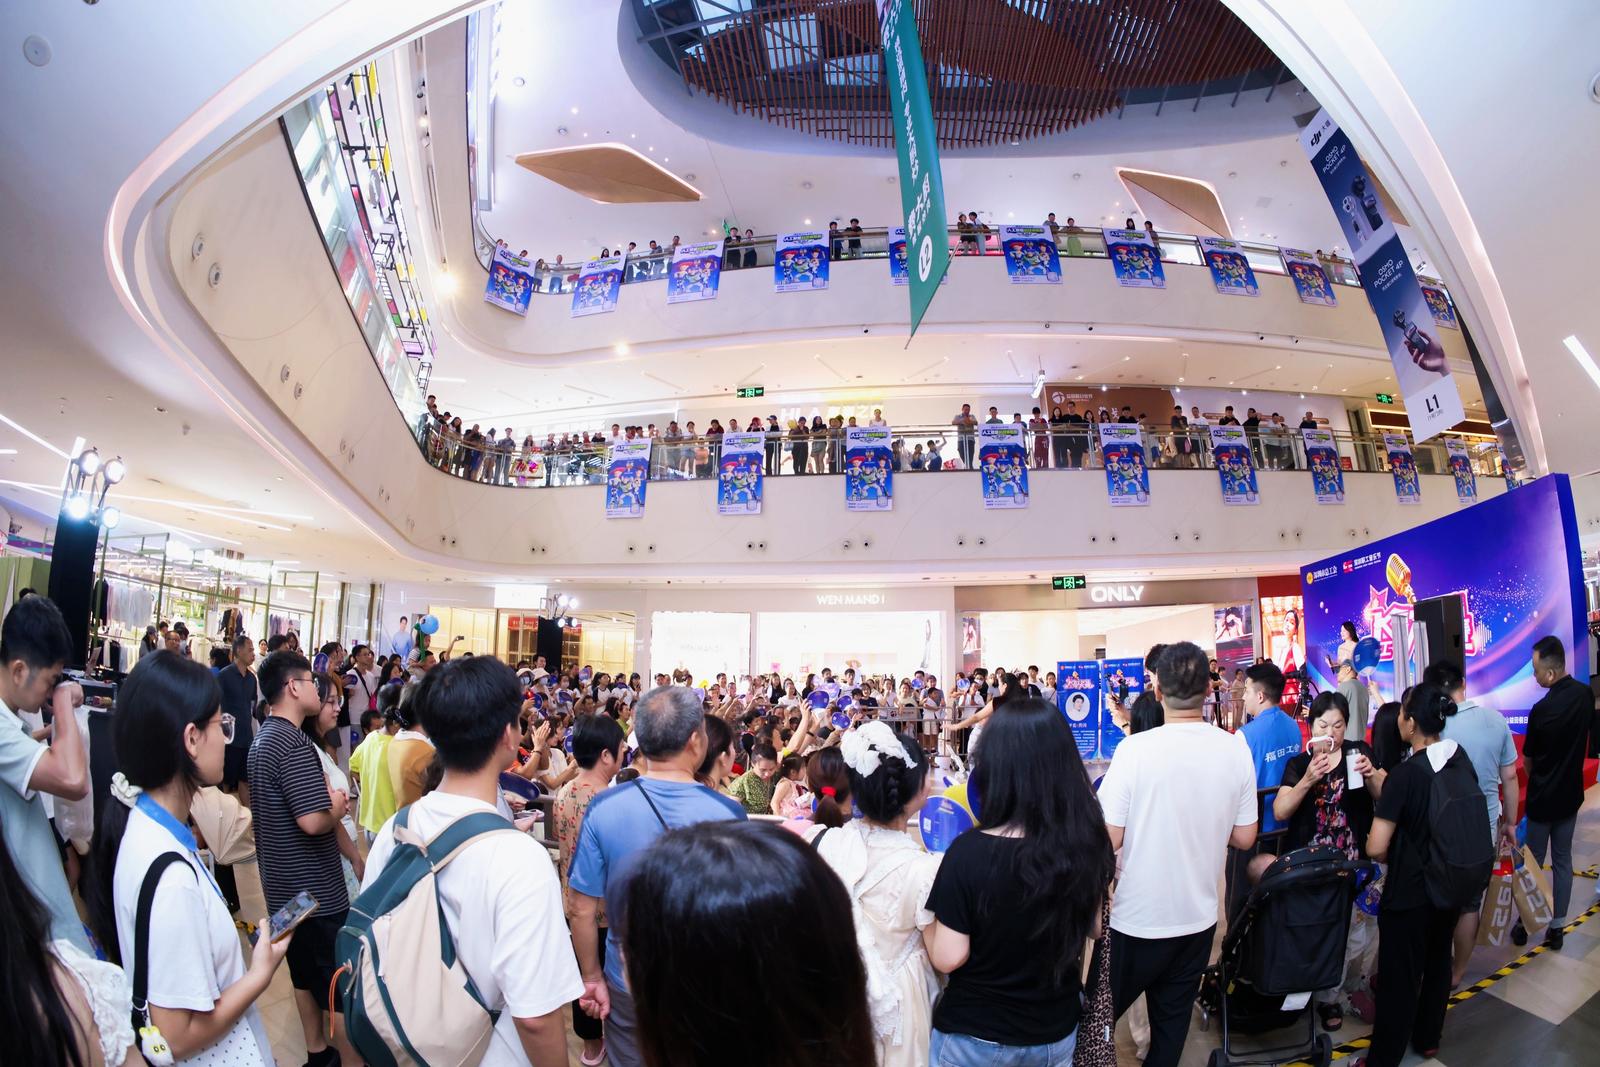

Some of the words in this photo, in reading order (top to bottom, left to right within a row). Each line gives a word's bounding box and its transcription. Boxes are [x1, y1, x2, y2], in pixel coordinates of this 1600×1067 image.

[1322, 152, 1340, 173] POCKET
[1325, 146, 1339, 162] OSMO
[1373, 265, 1395, 288] POCKET
[1378, 259, 1394, 276] OSMO
[1425, 393, 1440, 414] L1
[1091, 585, 1144, 602] ONLY
